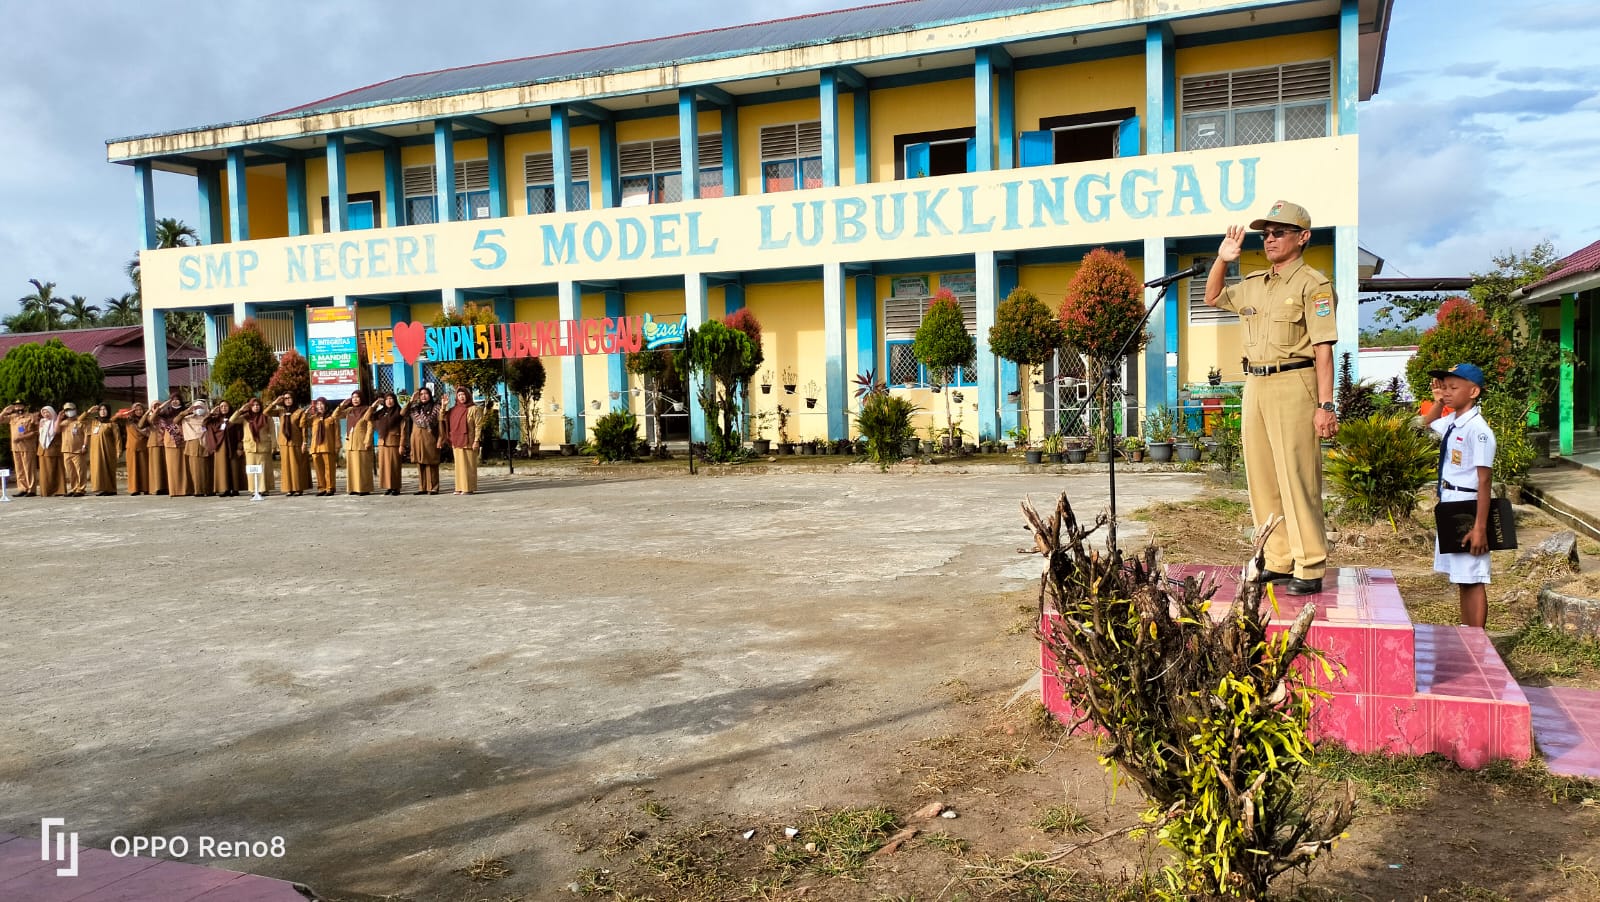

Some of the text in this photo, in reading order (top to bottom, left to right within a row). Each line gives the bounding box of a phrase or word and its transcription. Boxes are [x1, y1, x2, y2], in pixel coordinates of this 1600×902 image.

[178, 156, 1261, 291] SMP NEGERI 5 MODEL LUBUKLINGGAU
[317, 353, 351, 361] MANDIRI
[364, 329, 395, 365] WE
[425, 325, 475, 362] SMPN
[475, 324, 489, 360] 5
[489, 315, 642, 360] LUBUKLINGGAU
[1493, 508, 1504, 543] PANCASILA
